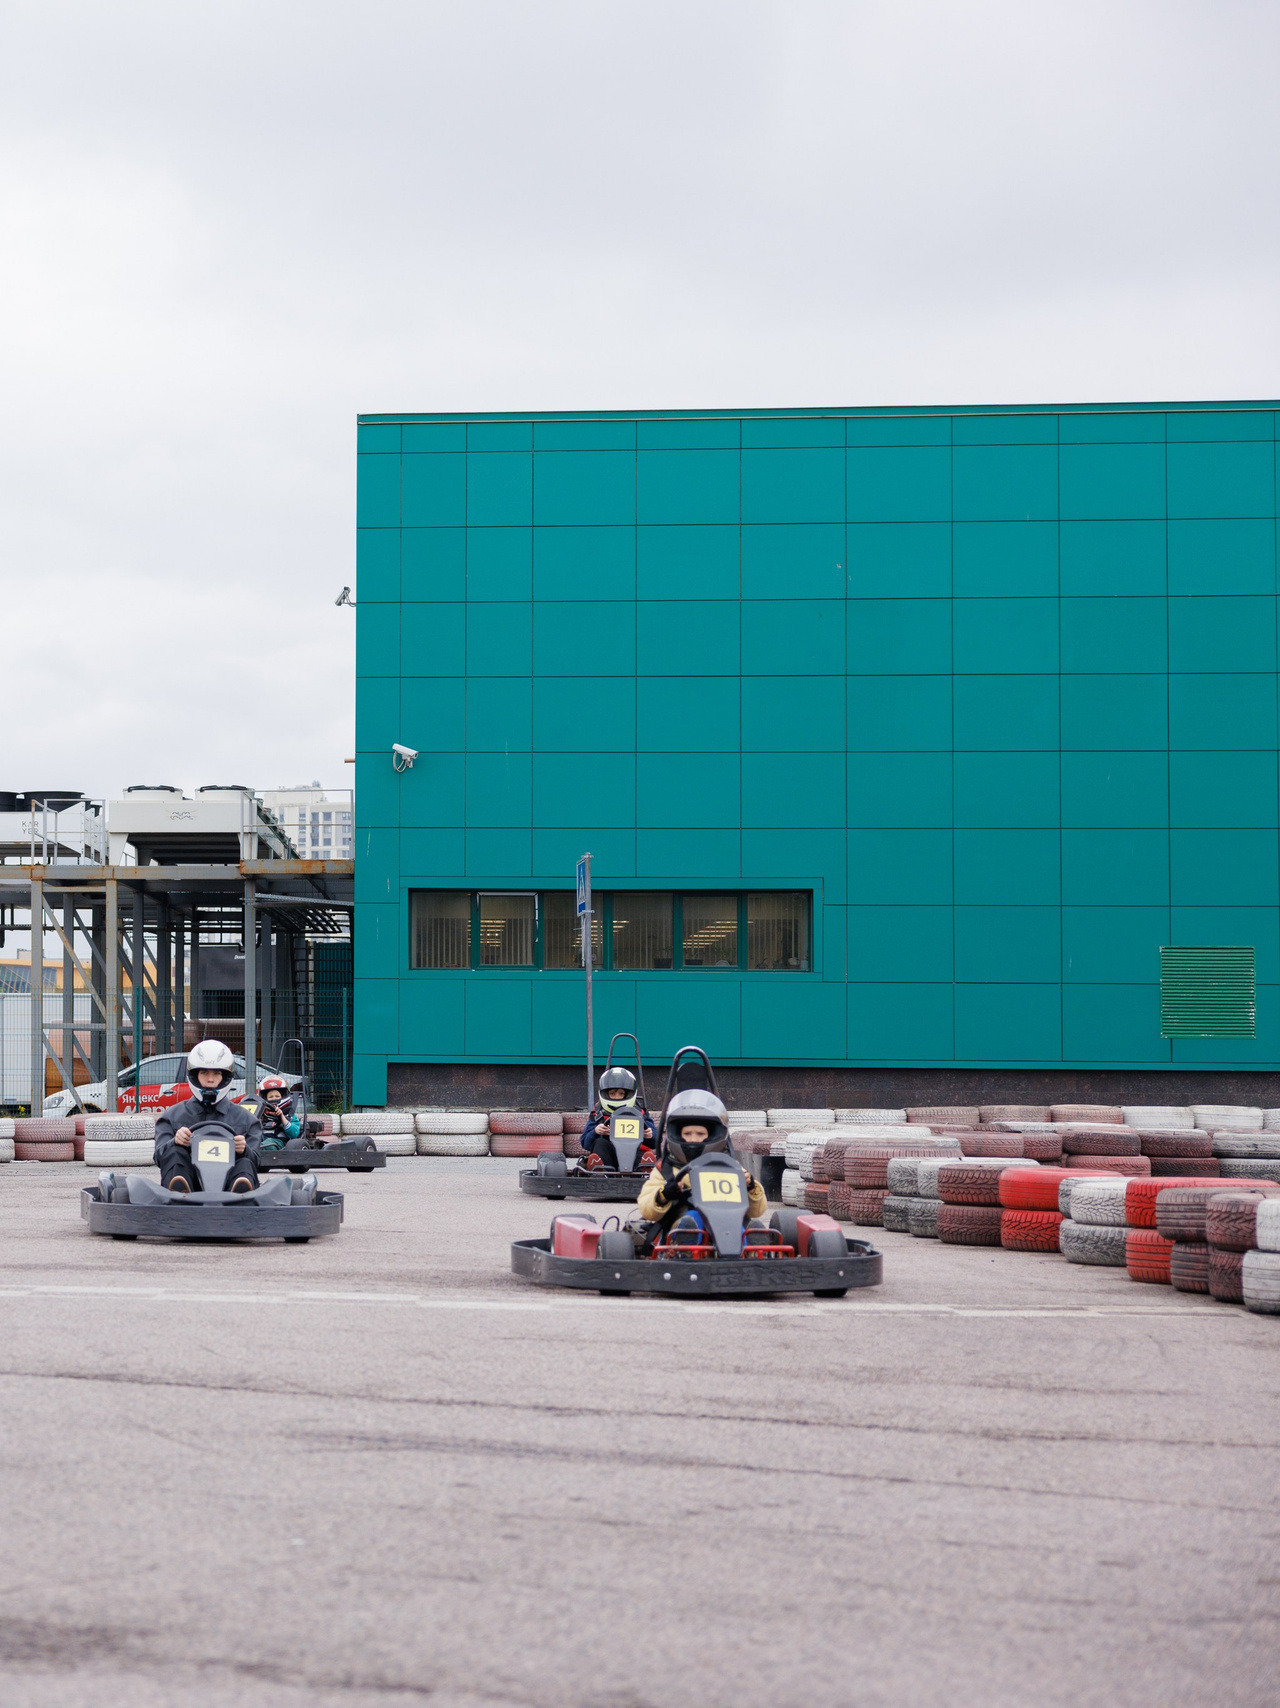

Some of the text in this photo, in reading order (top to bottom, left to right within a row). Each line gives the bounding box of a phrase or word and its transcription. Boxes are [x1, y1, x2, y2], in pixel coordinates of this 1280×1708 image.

[620, 1123, 635, 1134] 12
[207, 1146, 221, 1157] 4
[708, 1179, 733, 1195] 10
